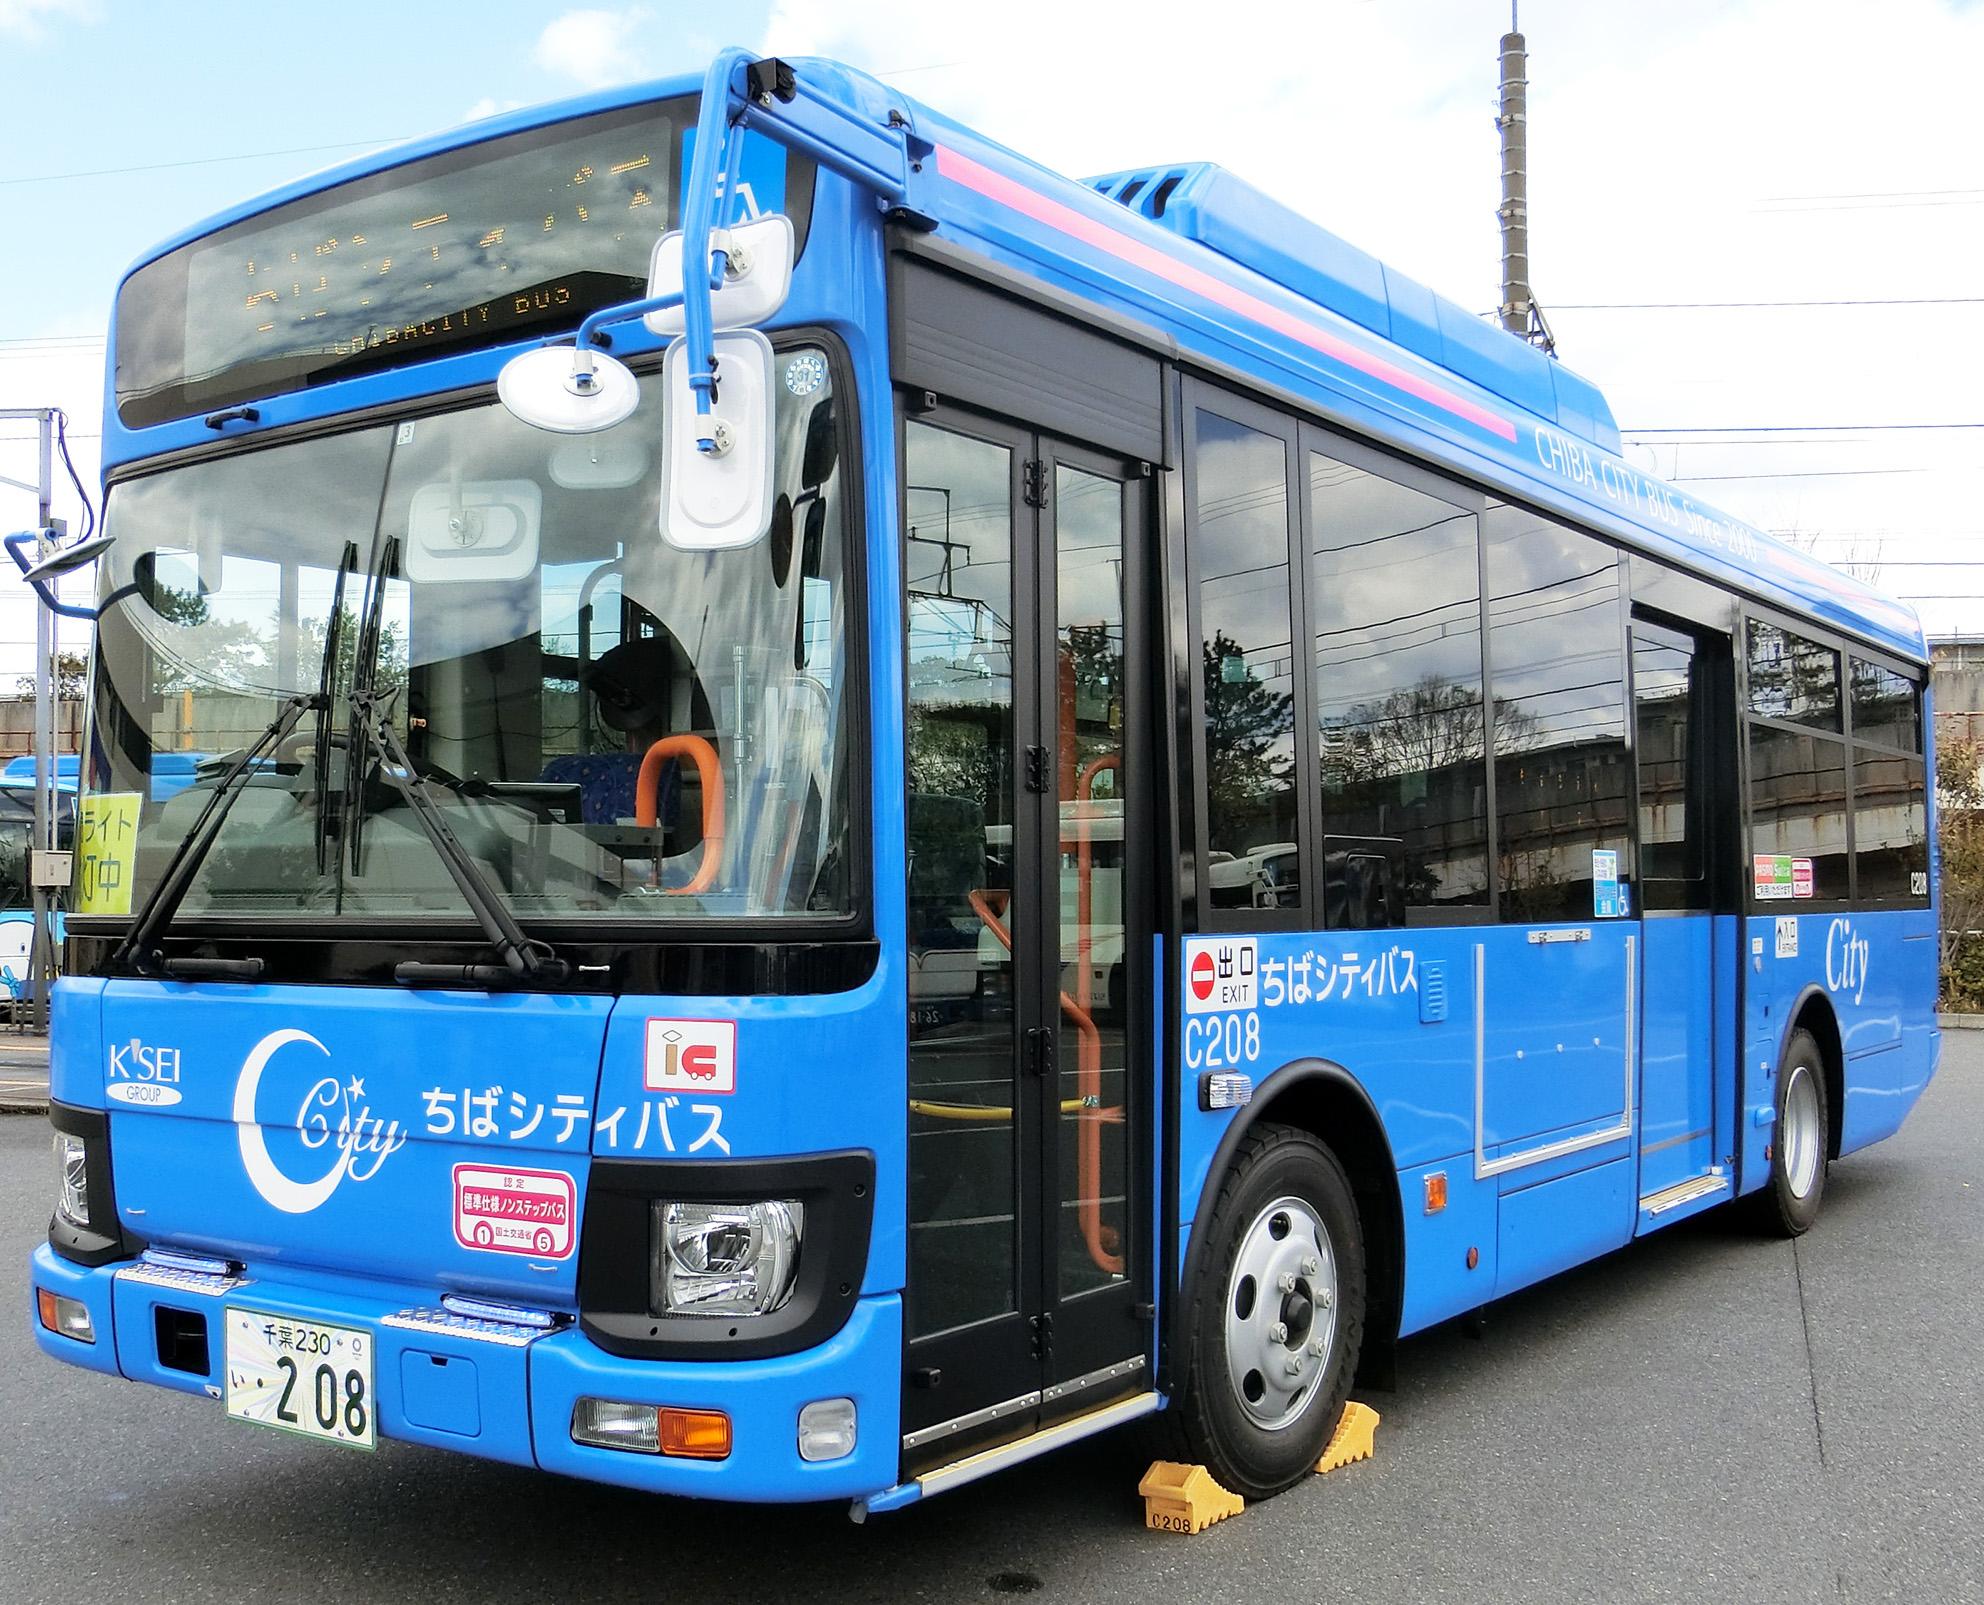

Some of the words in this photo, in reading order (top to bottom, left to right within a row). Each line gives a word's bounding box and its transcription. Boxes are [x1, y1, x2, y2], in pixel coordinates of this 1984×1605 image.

[1534, 427, 1598, 490] CHIBA
[1600, 459, 1640, 510] CITY
[1644, 480, 1679, 528] BUS
[1683, 499, 1723, 548] Since
[1218, 945, 1254, 979] 出口
[1826, 918, 1869, 1006] City
[1260, 945, 1418, 1007] ちばシティバス
[1222, 984, 1249, 1004] EXIT
[1185, 1011, 1260, 1069] C208
[126, 1085, 162, 1103] GROUP
[422, 1085, 731, 1156] ちばシティバス
[503, 1176, 525, 1189] 認定
[480, 1229, 486, 1243] 1
[495, 1227, 532, 1240] 国土交通省
[540, 1236, 548, 1250] 5
[1151, 1513, 1191, 1533] C208
